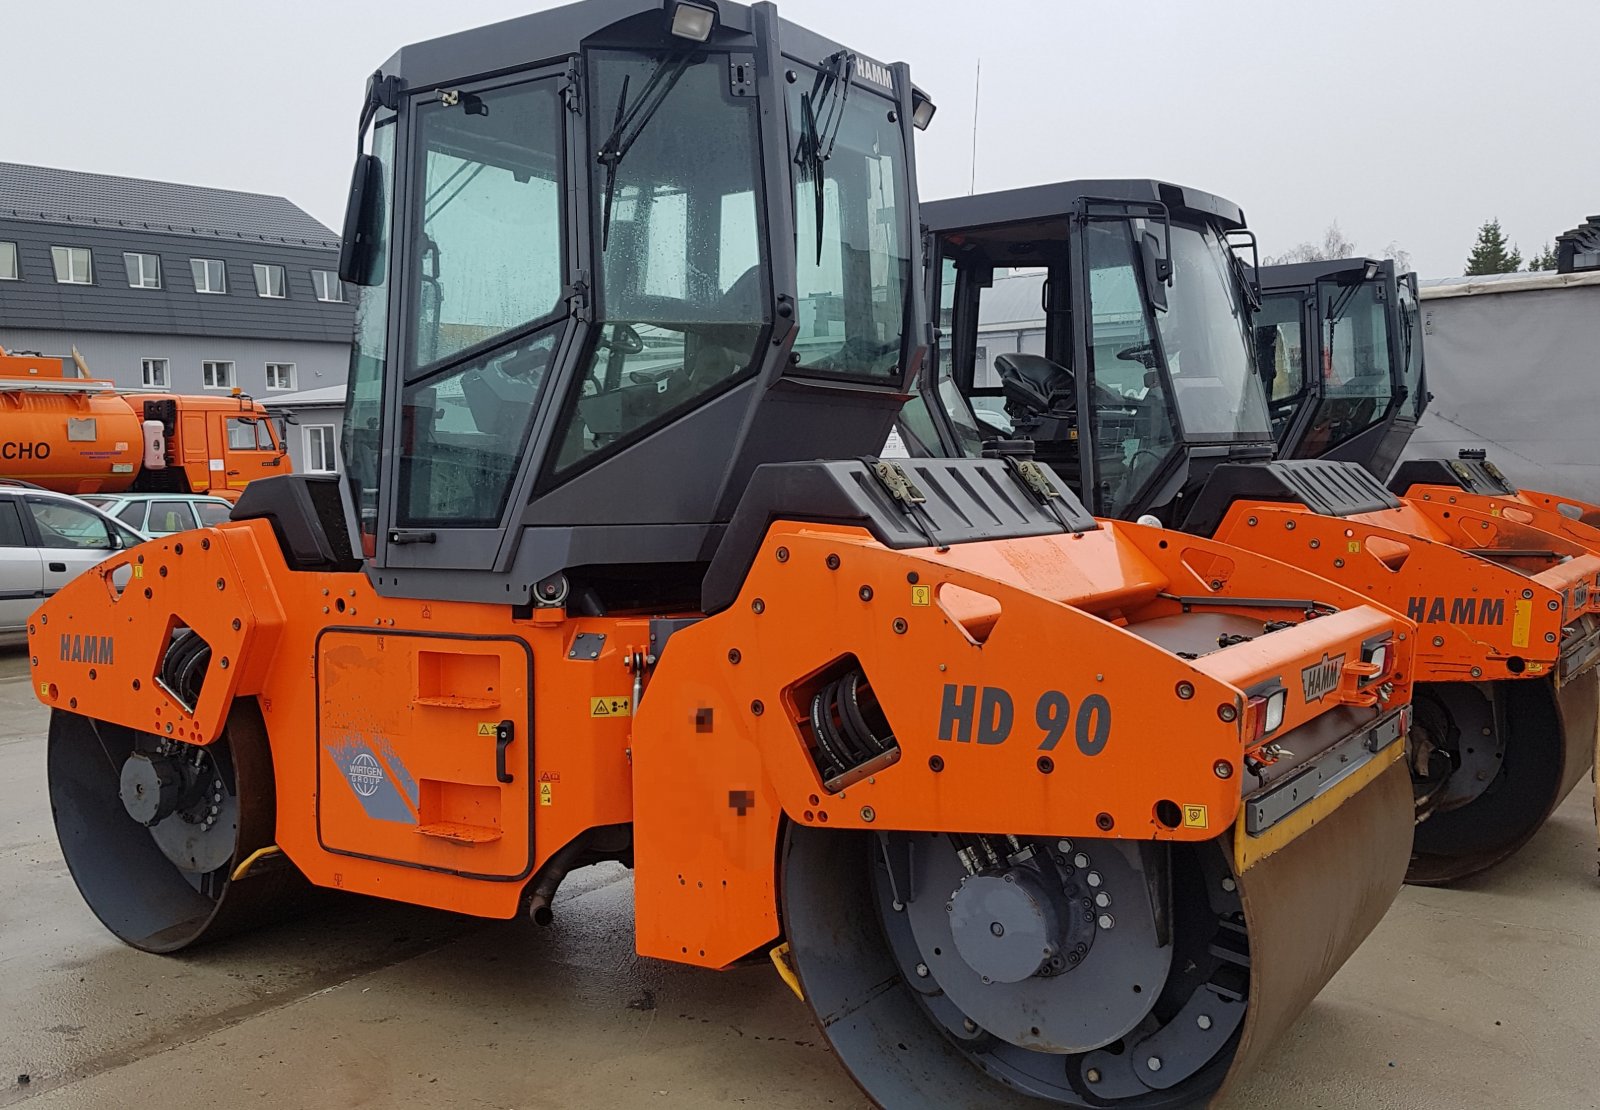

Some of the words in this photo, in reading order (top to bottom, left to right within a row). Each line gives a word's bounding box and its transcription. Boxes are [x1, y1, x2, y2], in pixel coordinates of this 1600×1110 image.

[856, 57, 893, 89] HAMM
[0, 441, 51, 460] СНО
[1407, 597, 1505, 626] HAMM
[60, 633, 114, 665] HAMM
[1307, 661, 1337, 696] HAMM
[938, 683, 1014, 746] HD
[1035, 690, 1112, 757] 90
[350, 765, 383, 777] WIRTGEN
[351, 775, 380, 784] GROUP
